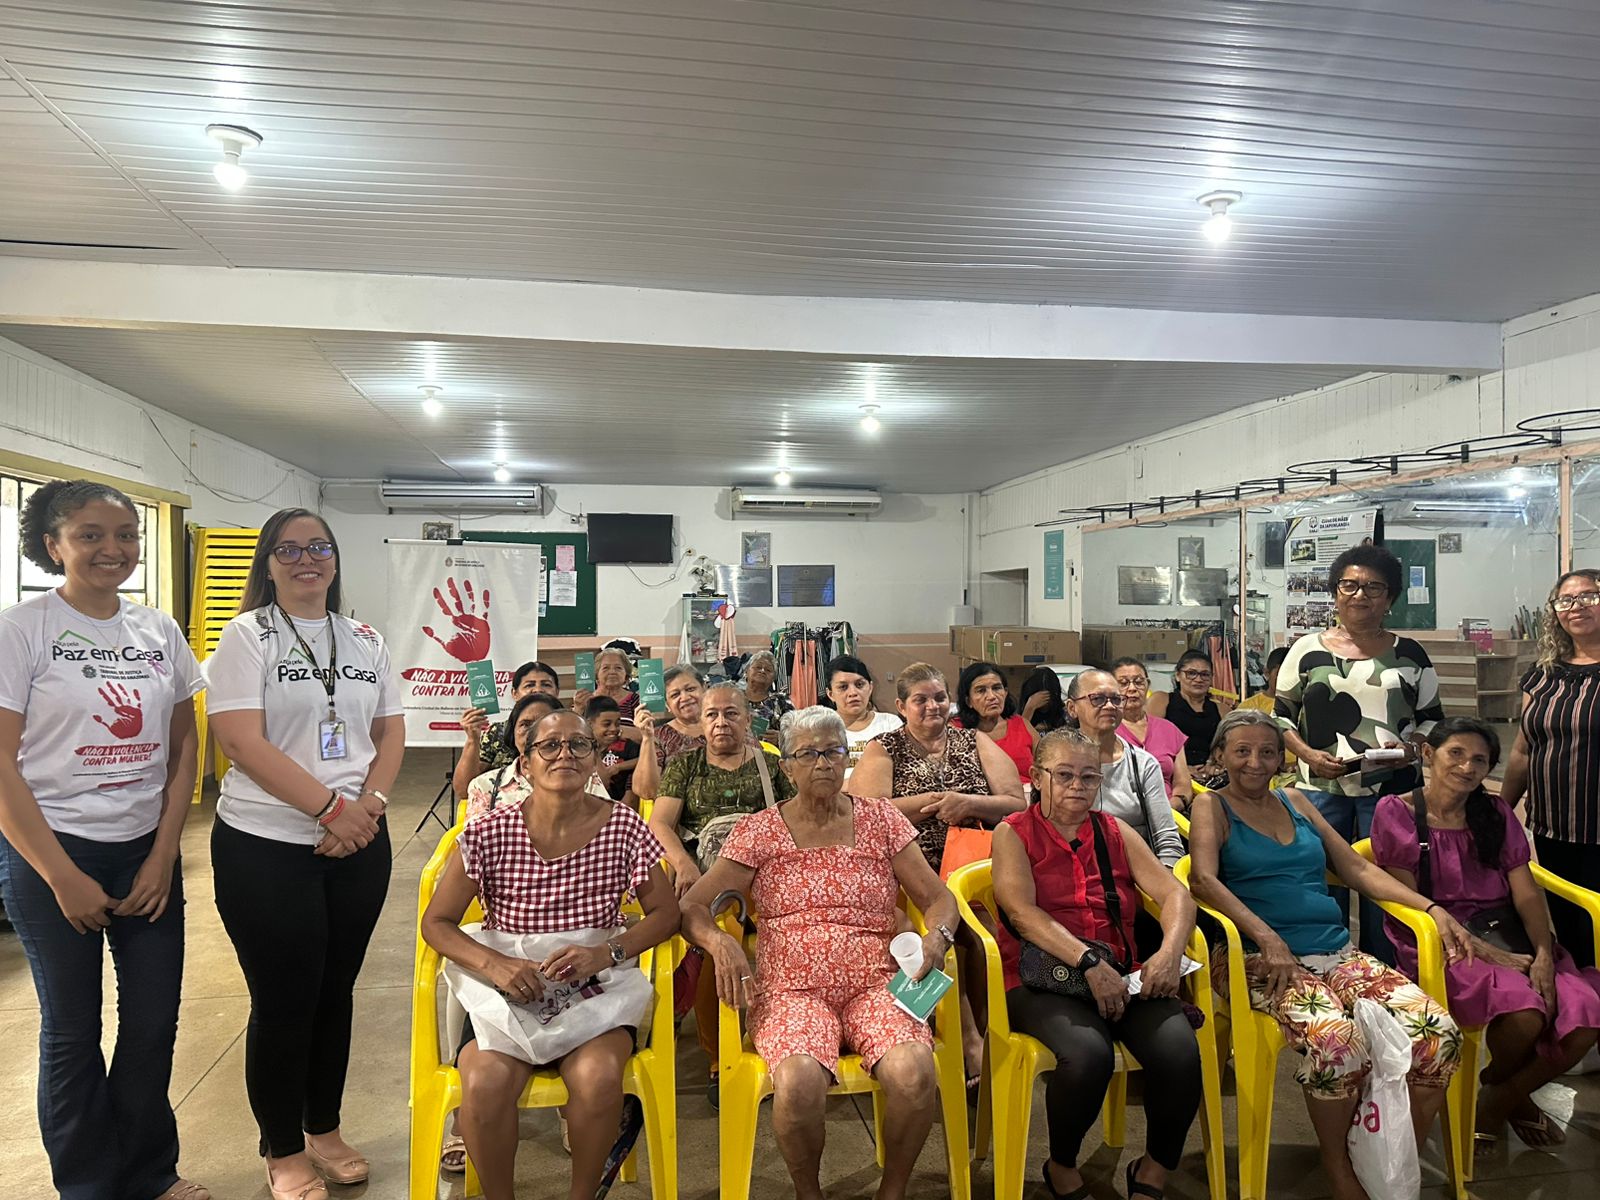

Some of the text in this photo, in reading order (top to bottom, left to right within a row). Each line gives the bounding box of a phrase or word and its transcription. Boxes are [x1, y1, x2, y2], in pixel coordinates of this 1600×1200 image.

[52, 645, 164, 662] Paz em Casa
[277, 665, 311, 683] Paz
[342, 665, 377, 684] Casa
[410, 668, 436, 682] NÃO
[412, 685, 455, 697] CONTRA
[83, 753, 152, 766] CONTRA MULHER!
